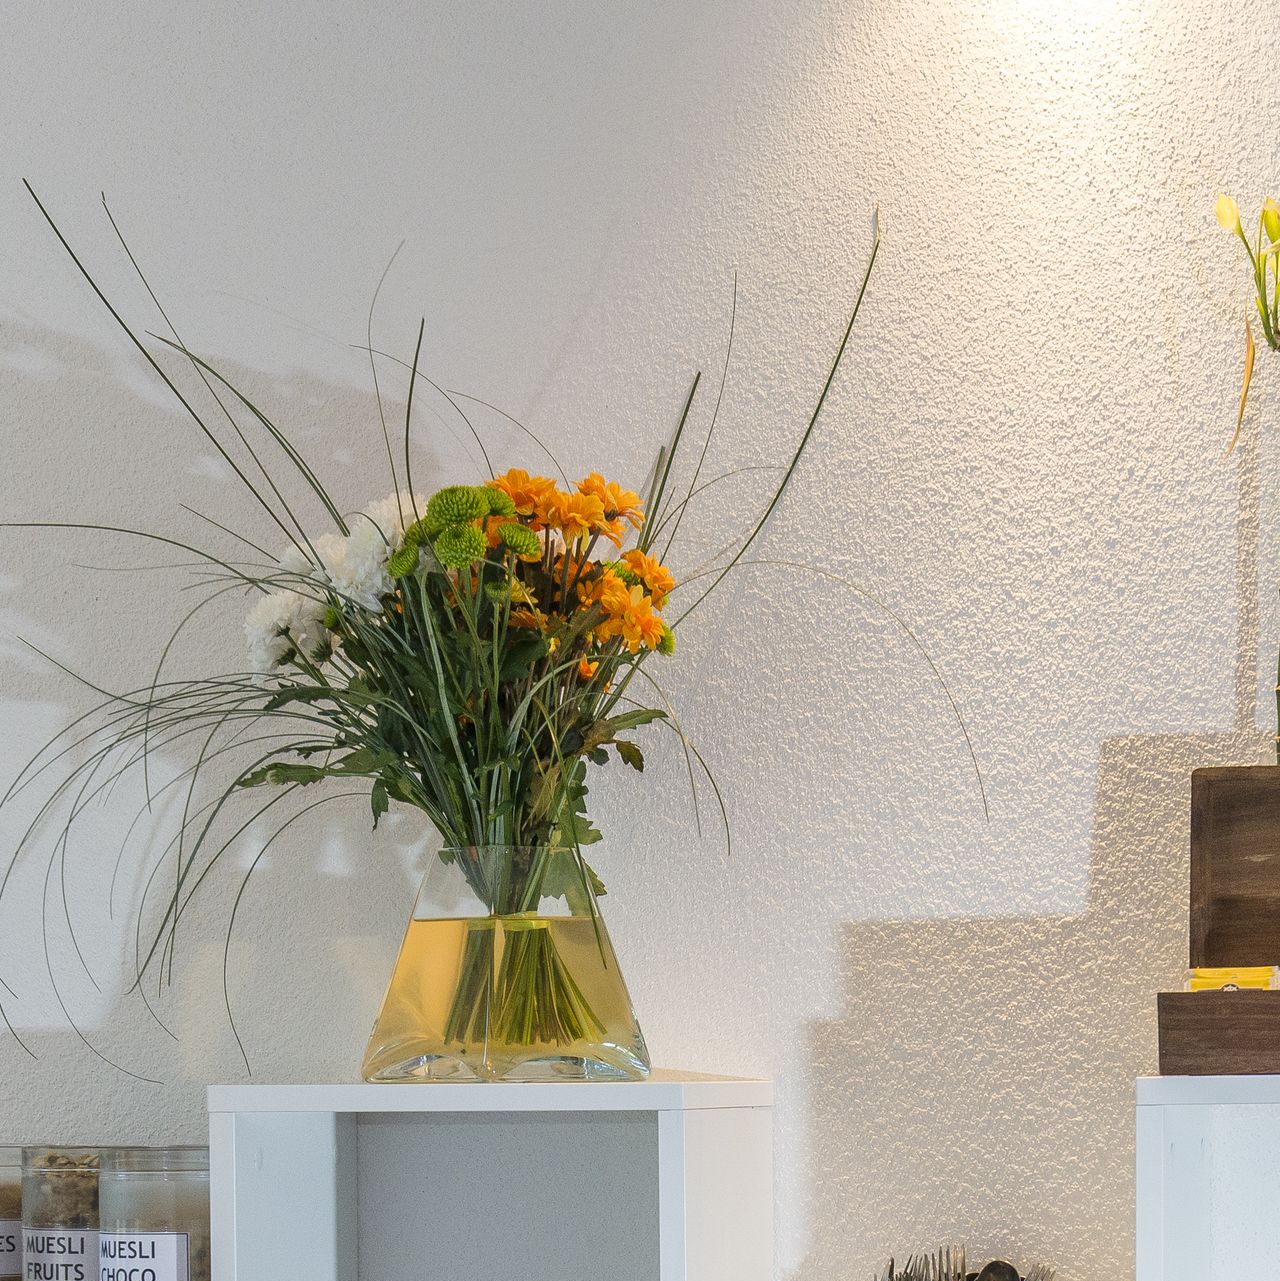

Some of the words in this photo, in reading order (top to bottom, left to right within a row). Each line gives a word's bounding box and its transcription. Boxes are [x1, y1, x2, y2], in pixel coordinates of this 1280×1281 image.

[26, 1235, 85, 1255] MUESLI
[100, 1240, 156, 1259] MUESLI
[27, 1262, 85, 1281] FRUITS
